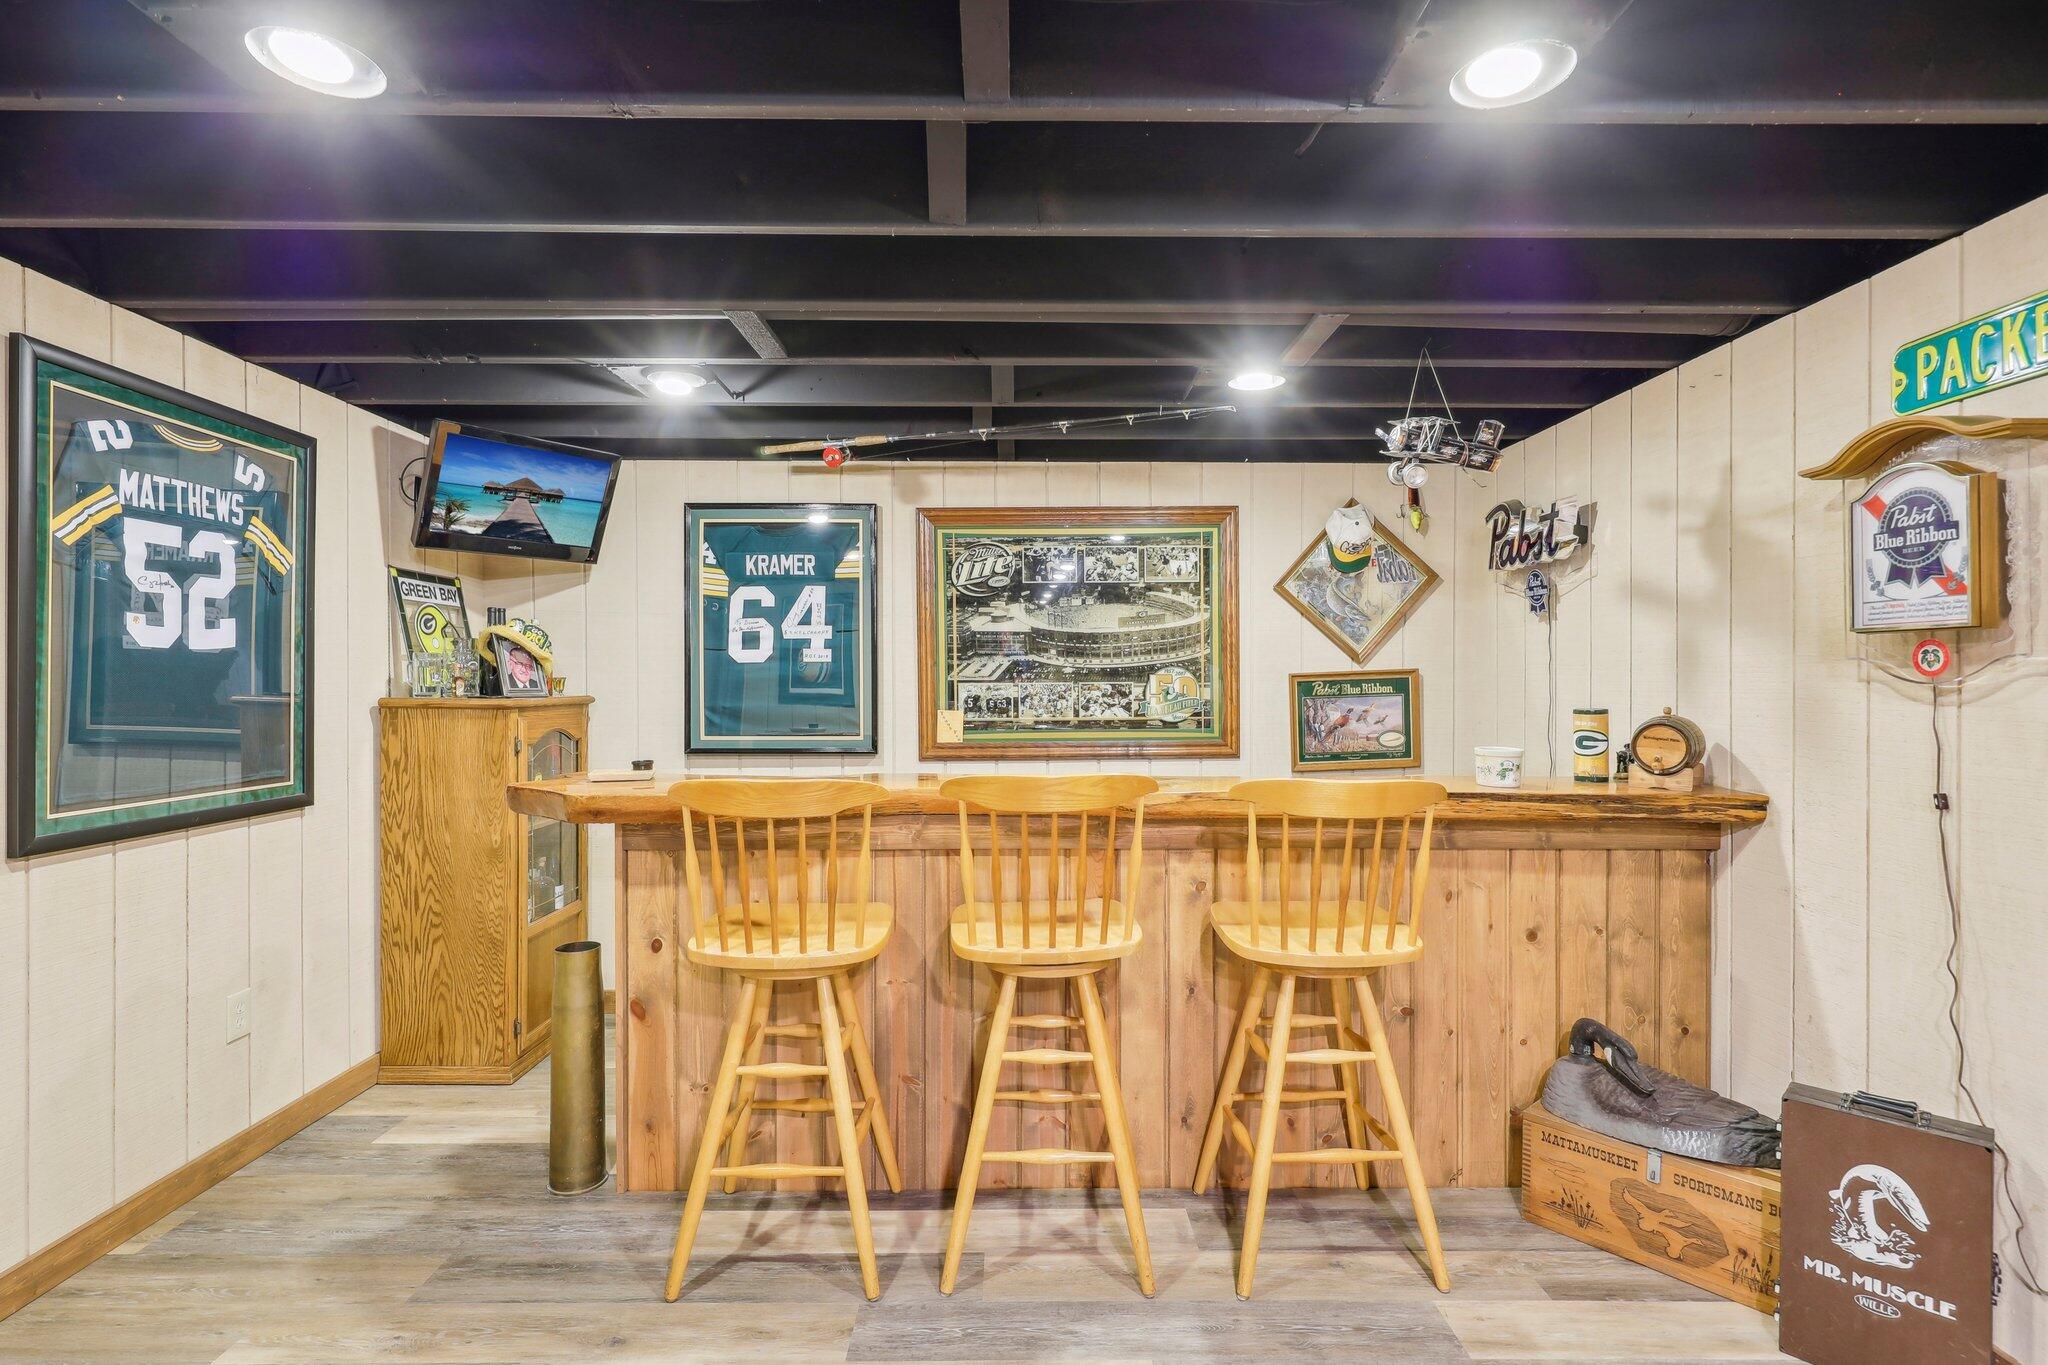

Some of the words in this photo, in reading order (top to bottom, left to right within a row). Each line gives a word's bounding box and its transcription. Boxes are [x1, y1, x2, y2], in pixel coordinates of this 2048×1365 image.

[118, 468, 244, 526] MATTHEWS
[1891, 503, 1937, 530] Pabst
[1485, 502, 1560, 570] Pabst
[1874, 533, 1904, 552] Blue
[1906, 525, 1957, 546] Ribbon
[969, 546, 1007, 560] Miller
[1902, 546, 1925, 554] BEER
[745, 554, 816, 576] KRAMER
[956, 556, 1014, 587] Lite
[123, 517, 236, 650] 52
[400, 580, 438, 600] GREEN
[440, 586, 457, 603] BAY
[728, 586, 832, 663] 64
[1312, 681, 1340, 695] Pabst
[1341, 684, 1361, 694] Blue
[1541, 1131, 1639, 1171] MATTAMUSKEET
[1673, 1173, 1763, 1212] SPORTSMANS
[1803, 1255, 1848, 1283] MR.
[1852, 1271, 1957, 1321] MUSCLE
[1859, 1296, 1897, 1315] WILLE
